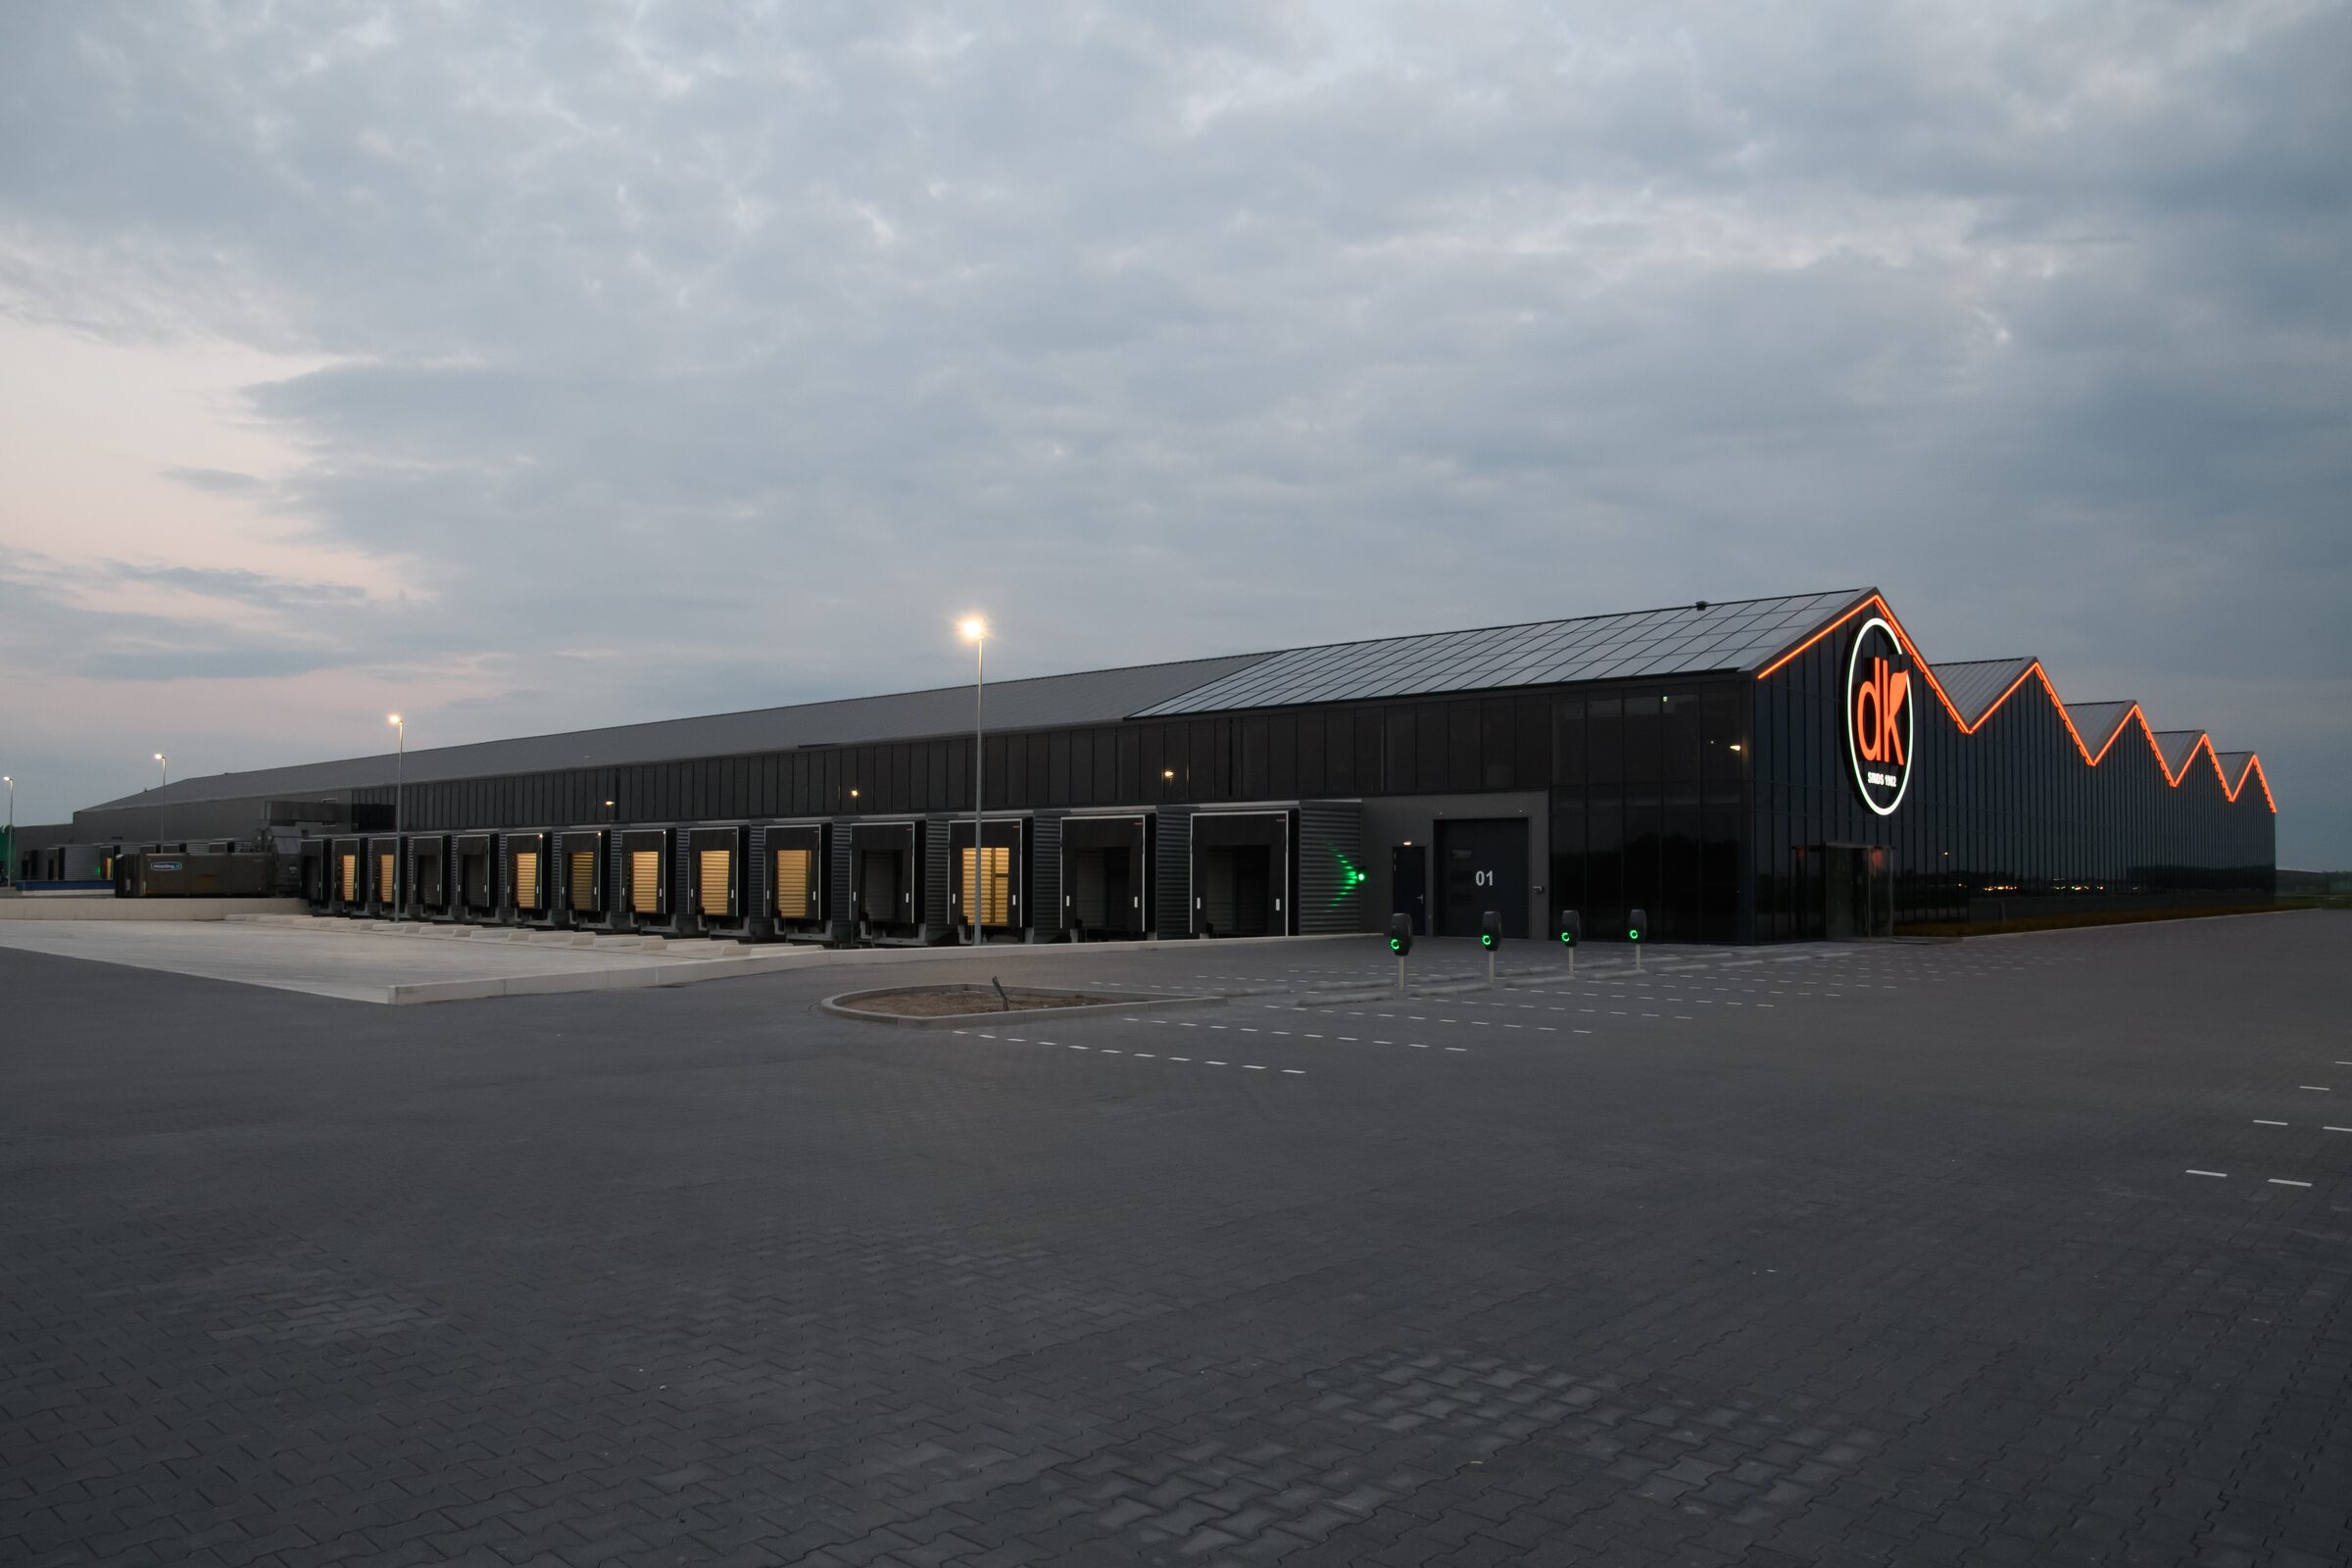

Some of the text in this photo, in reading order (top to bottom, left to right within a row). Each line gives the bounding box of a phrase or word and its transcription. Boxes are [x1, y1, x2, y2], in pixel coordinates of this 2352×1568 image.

[1857, 656, 1909, 765] dk
[1867, 771, 1885, 786] SINDS
[1475, 869, 1494, 887] 01
